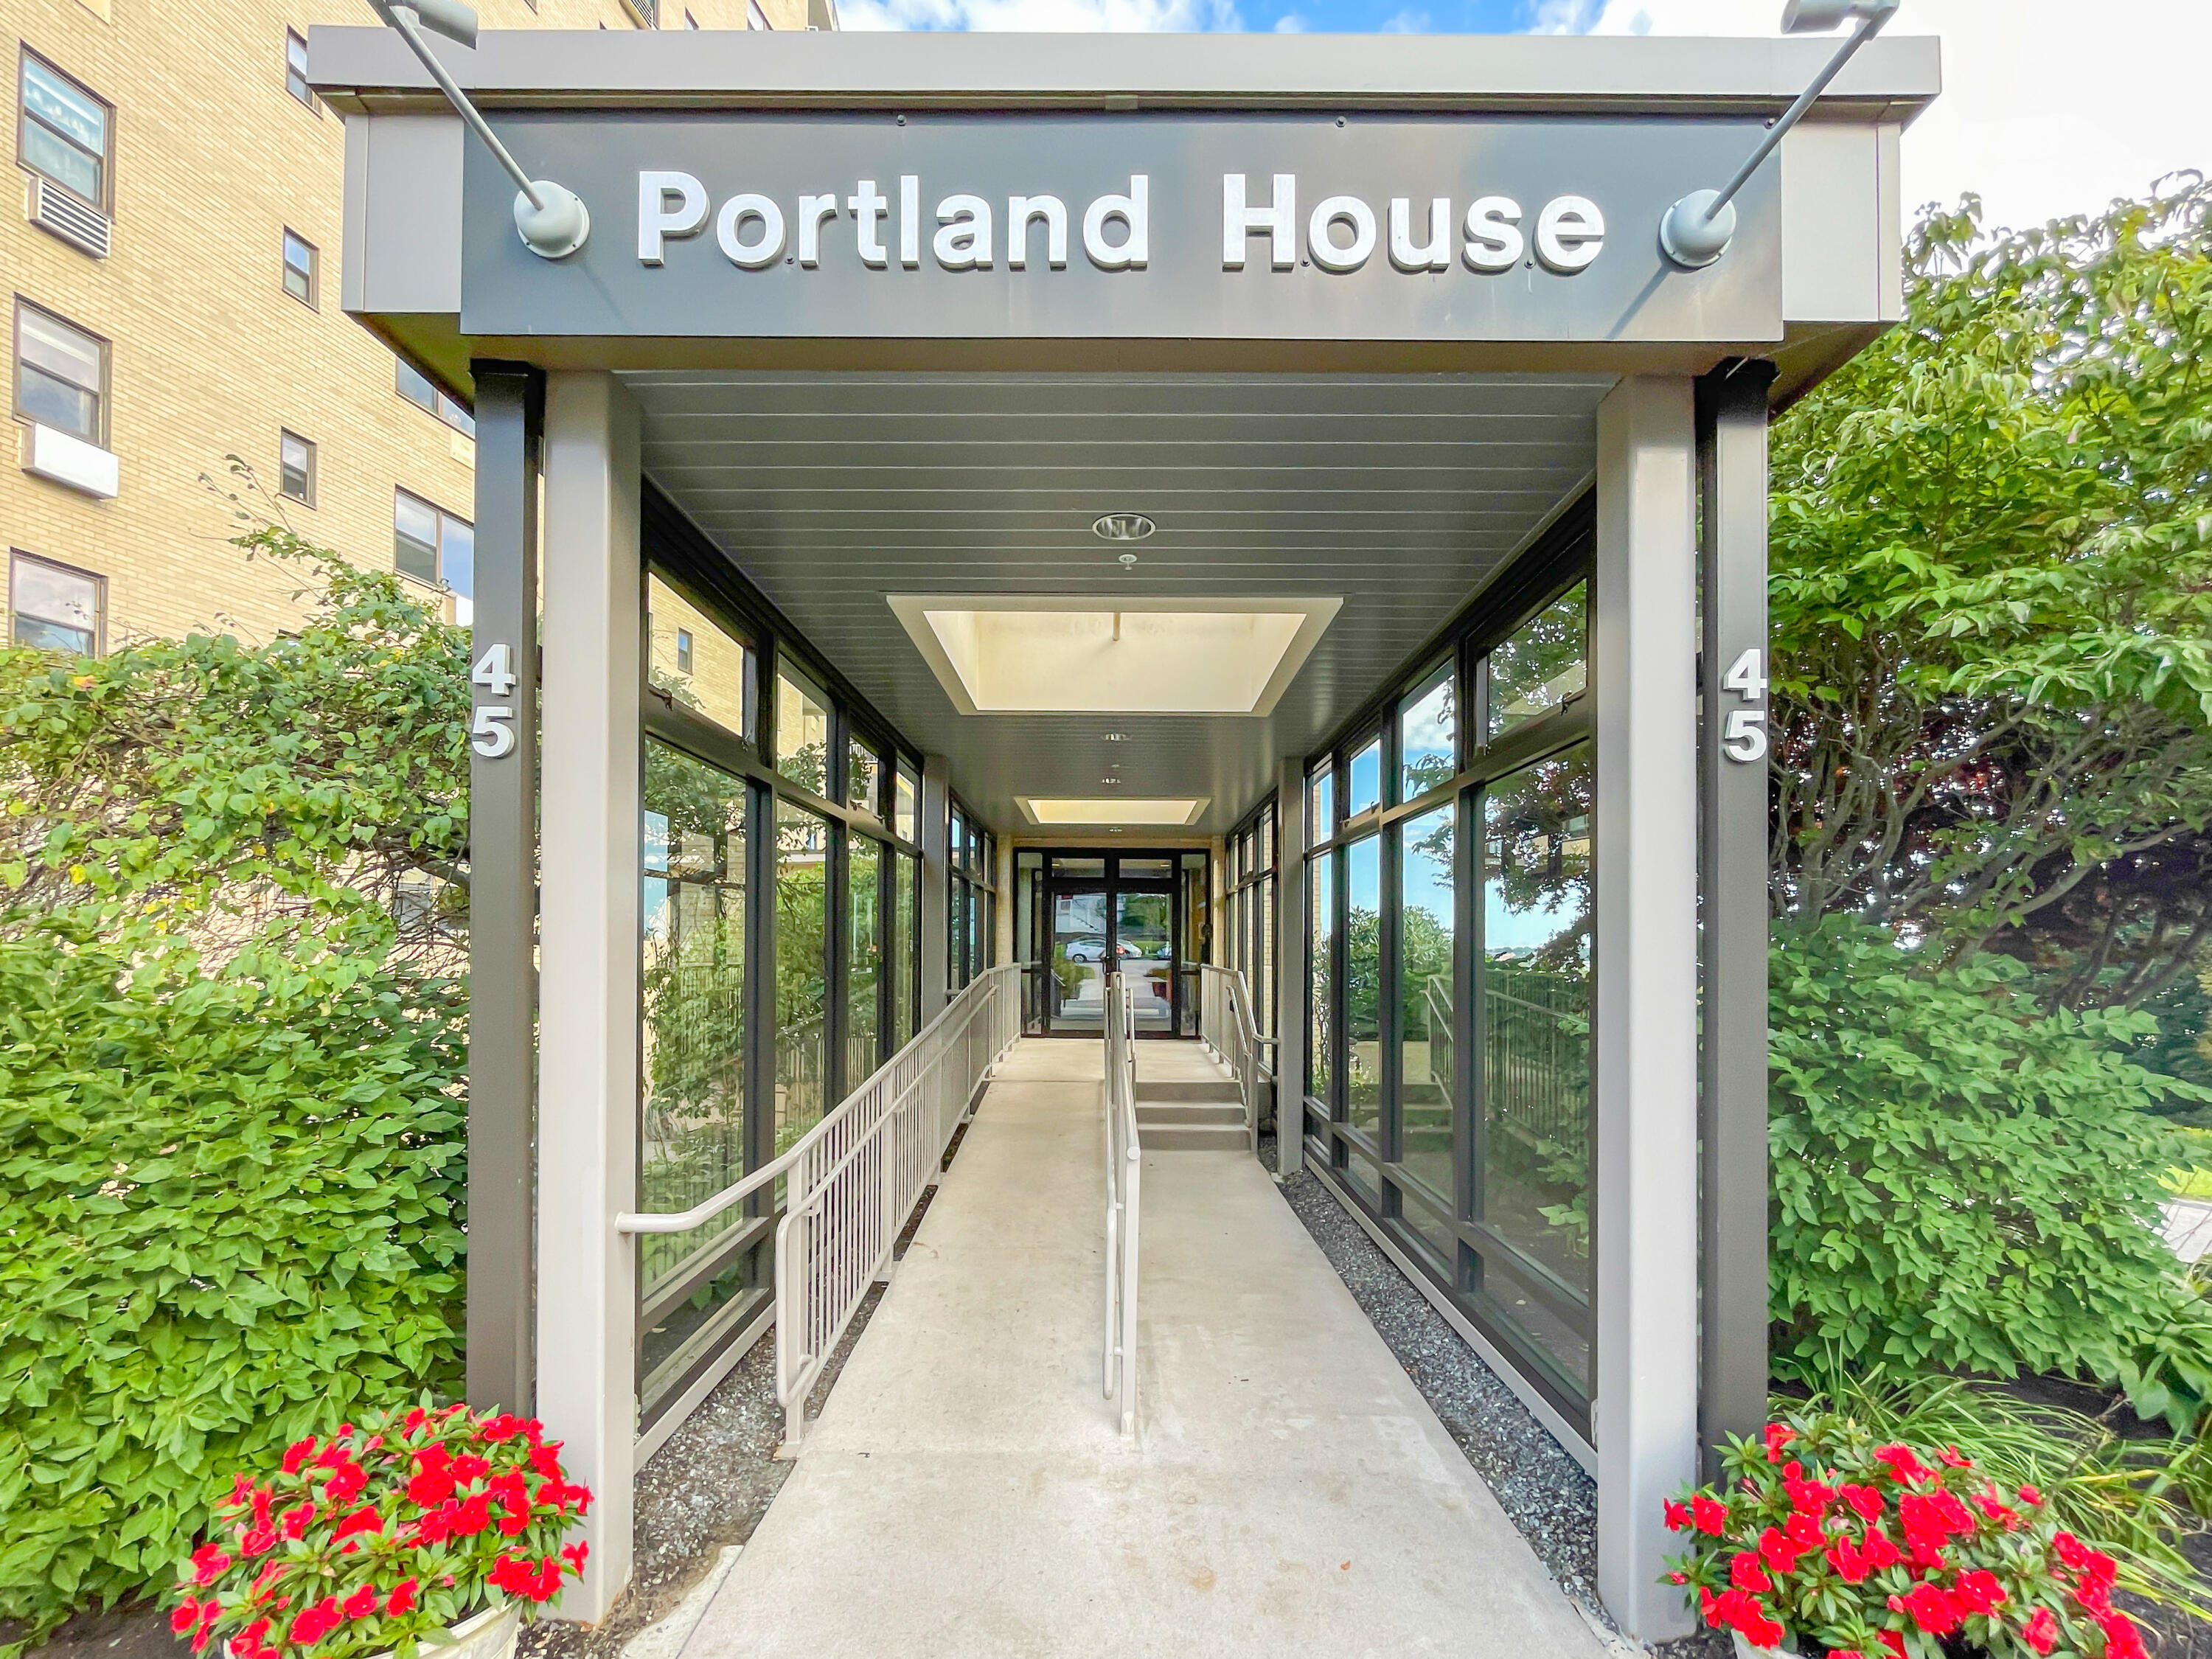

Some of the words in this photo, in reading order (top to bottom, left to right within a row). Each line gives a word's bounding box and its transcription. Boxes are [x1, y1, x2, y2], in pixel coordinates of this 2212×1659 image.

[637, 170, 1149, 271] Portland
[1222, 173, 1605, 274] House
[472, 643, 516, 758] 45
[1723, 648, 1767, 762] 45
